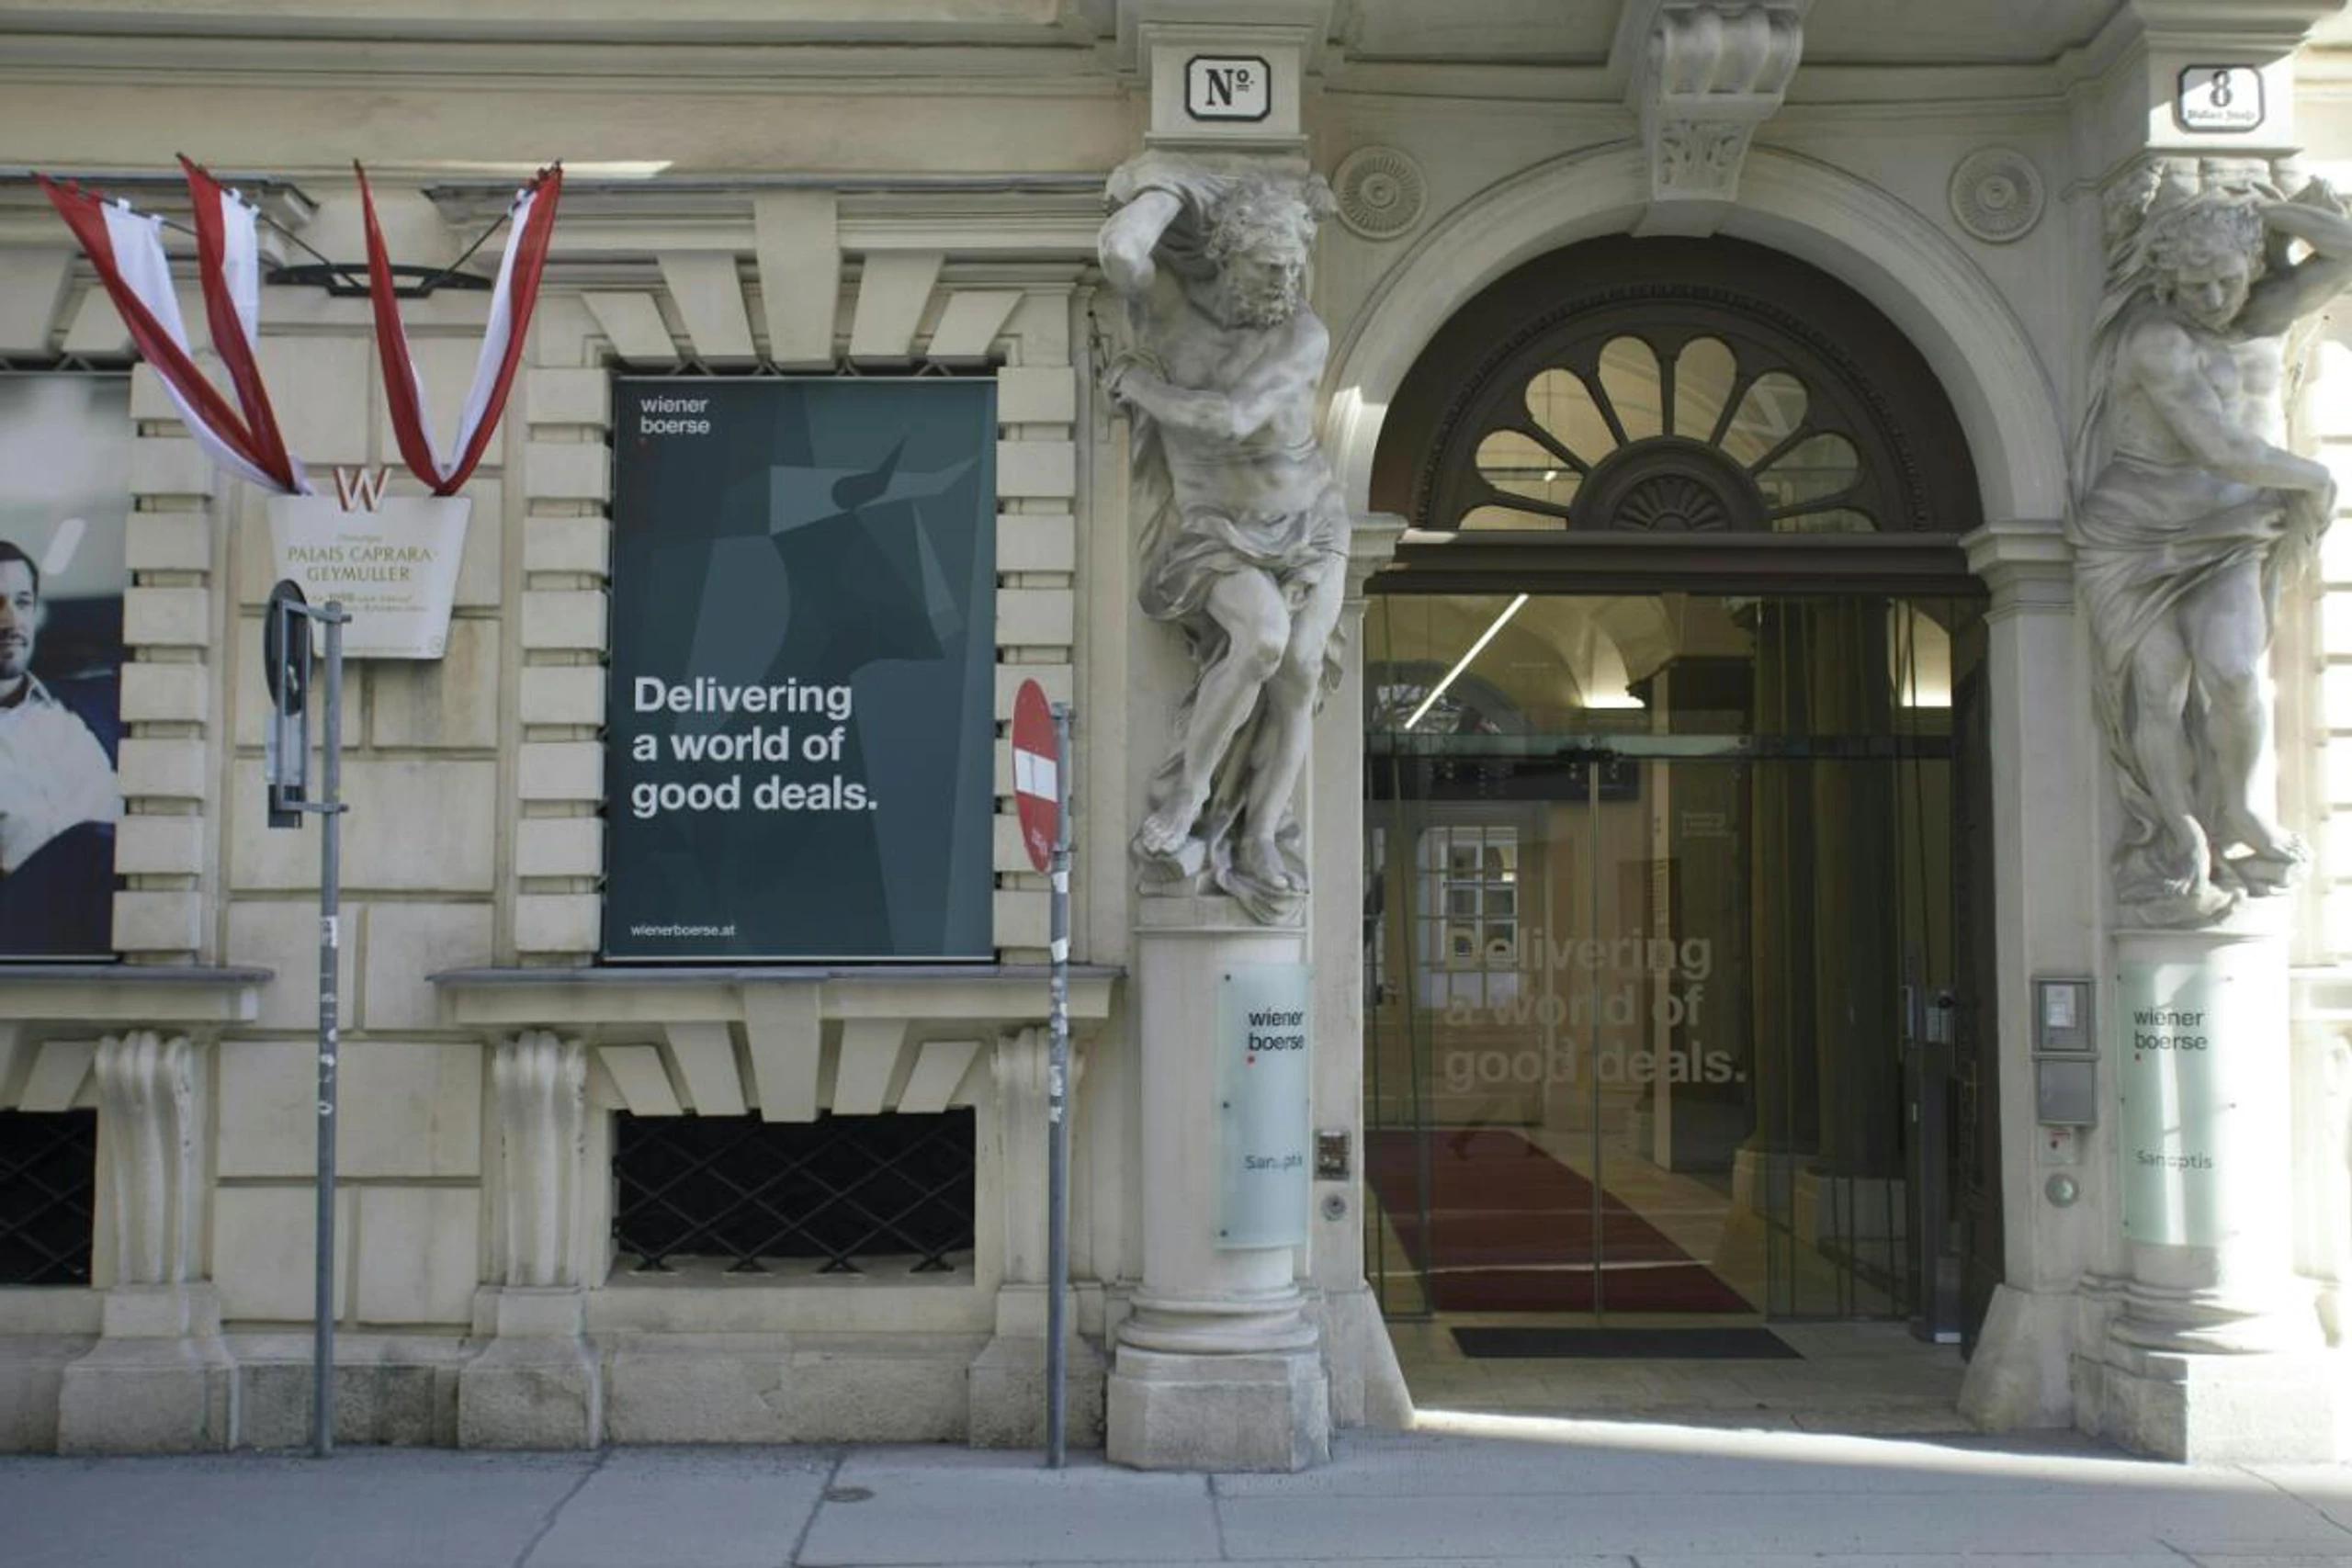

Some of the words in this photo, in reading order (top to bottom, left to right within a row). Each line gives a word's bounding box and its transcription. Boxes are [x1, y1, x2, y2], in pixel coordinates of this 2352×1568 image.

[2210, 70, 2233, 107] 8
[640, 395, 708, 413] wiener
[640, 416, 711, 434] boerse
[332, 466, 392, 513] W
[288, 547, 344, 562] PALAIS
[635, 677, 853, 721] Delivering
[633, 734, 658, 761] a
[671, 726, 789, 761] world
[802, 726, 846, 761] of
[632, 774, 741, 818] good
[753, 774, 878, 811] deals.
[631, 923, 736, 937] wienerboerse.at
[1446, 928, 1712, 980] Delivering
[1249, 1008, 1304, 1027] wiener
[1652, 984, 1704, 1026] of
[2134, 1008, 2205, 1027] wiener
[1249, 1032, 1305, 1052] boerse
[2134, 1031, 2209, 1051] boerse
[1444, 1037, 1577, 1092] good
[1598, 1040, 1747, 1083] deals.
